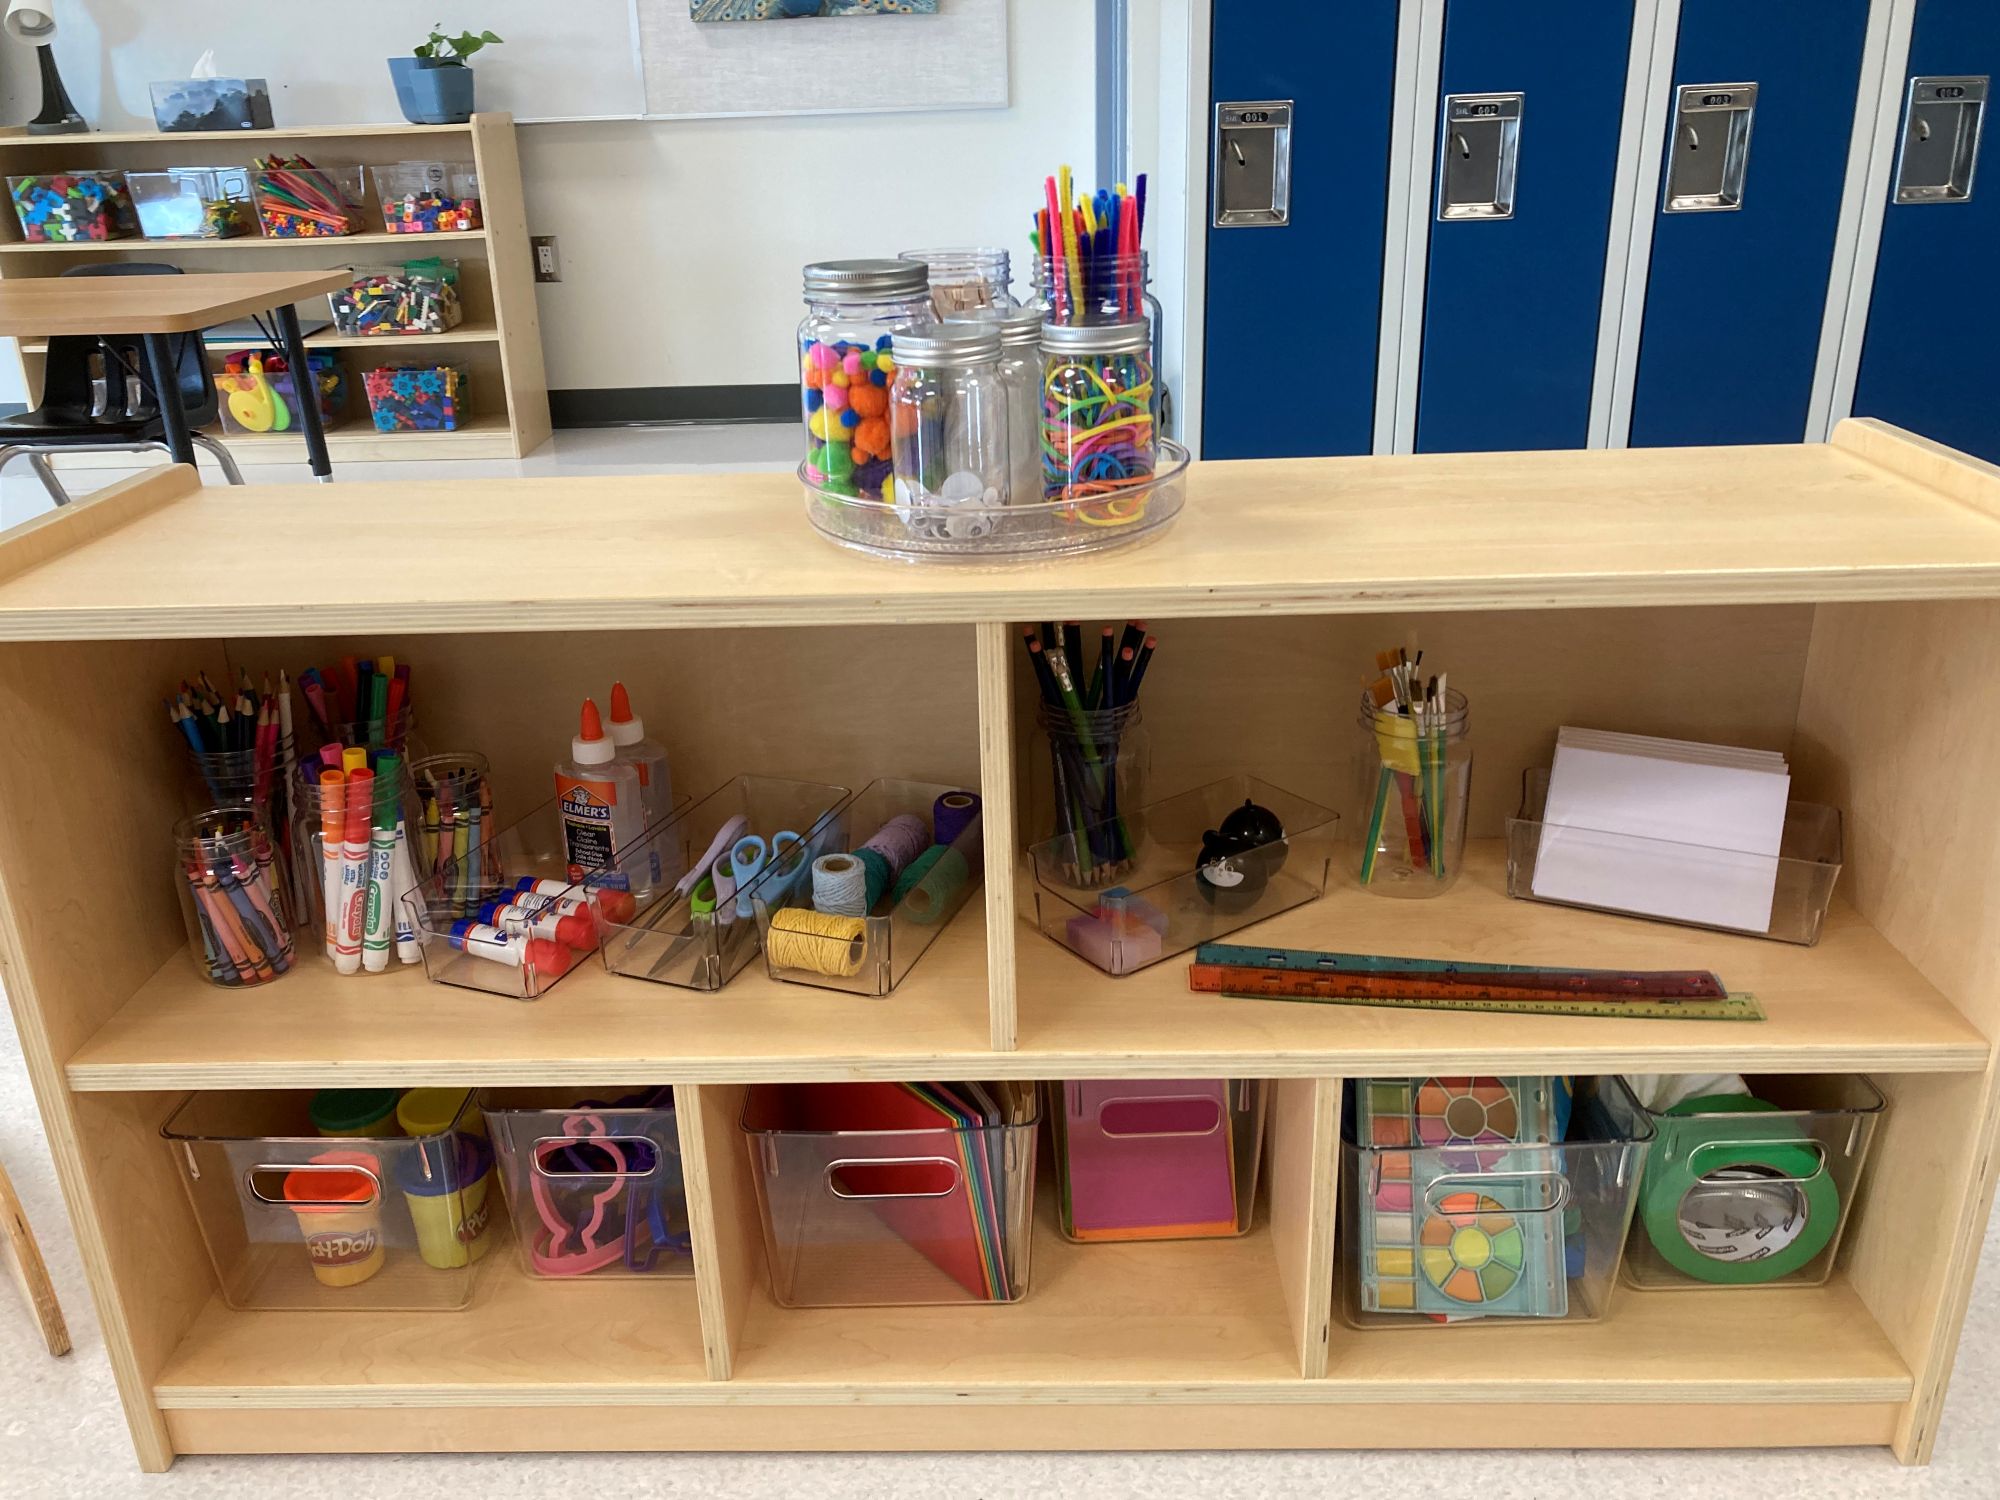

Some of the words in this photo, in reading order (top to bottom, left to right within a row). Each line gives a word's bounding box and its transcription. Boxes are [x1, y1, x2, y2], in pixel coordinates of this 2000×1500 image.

[1245, 113, 1263, 122] 001
[563, 802, 608, 818] ELMER'S
[576, 829, 596, 838] Clear
[576, 836, 598, 845] Claire
[352, 893, 364, 937] Crayola
[367, 884, 378, 930] Crayola
[311, 1230, 375, 1258] ay-Doh
